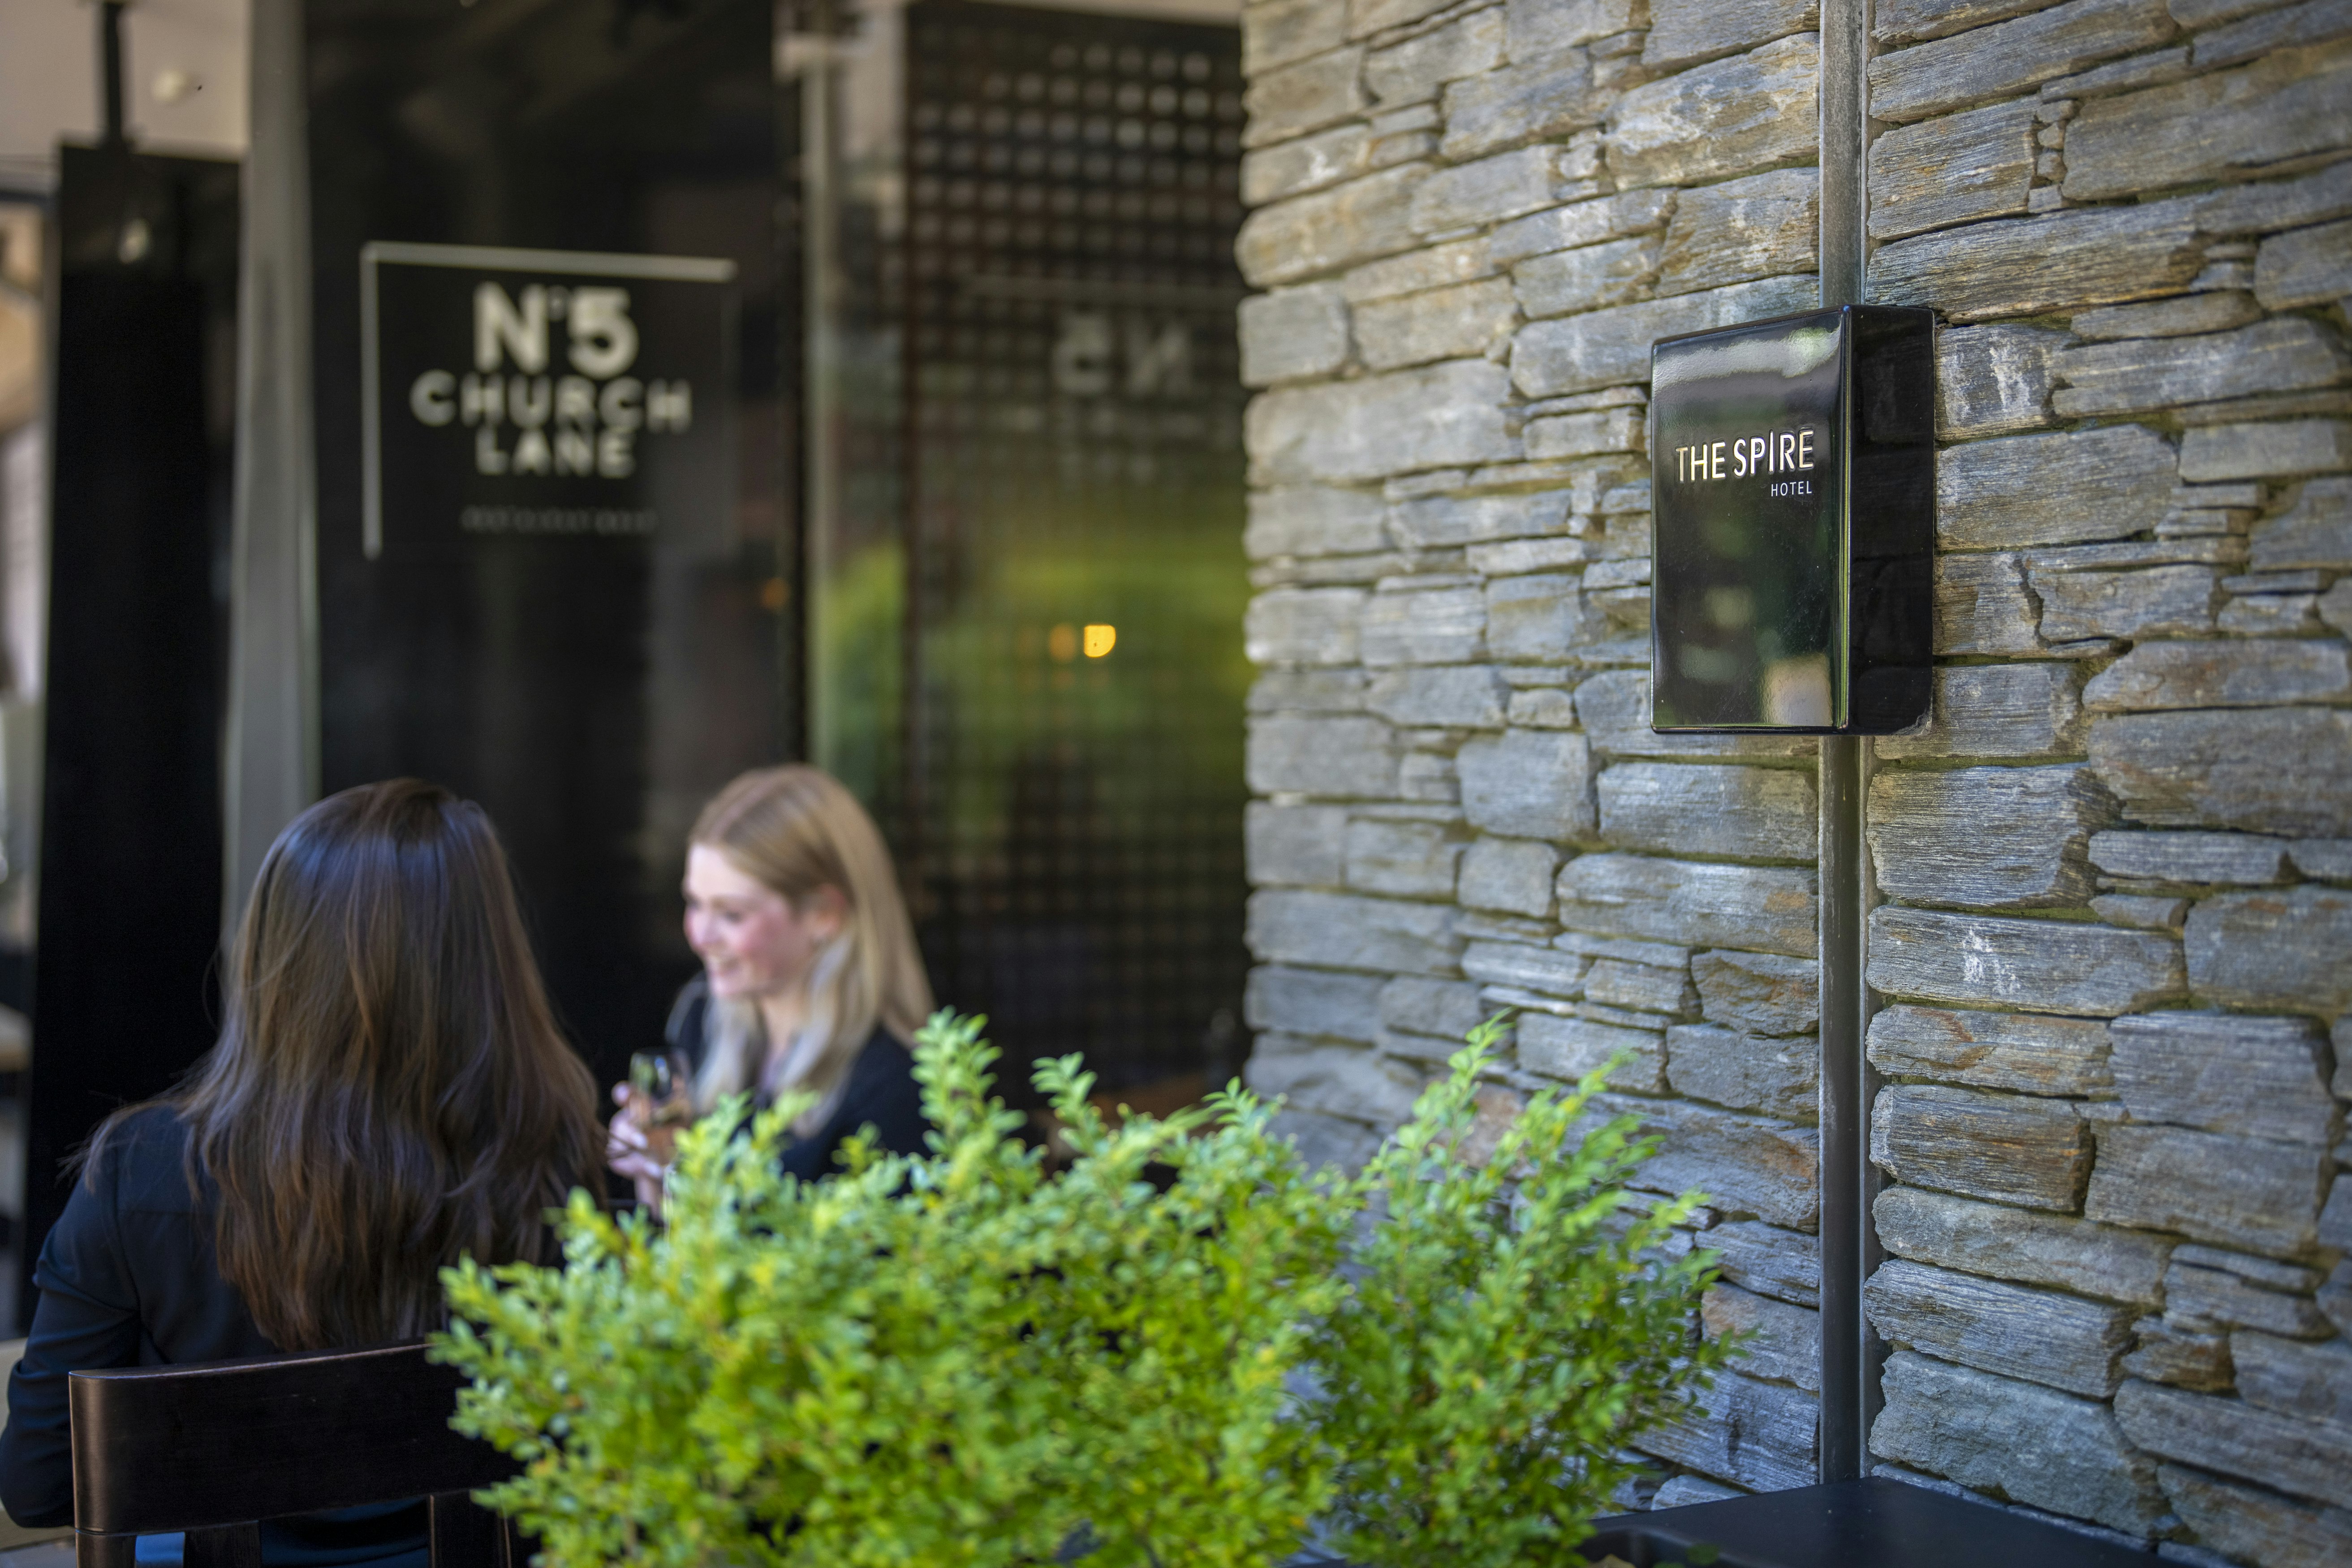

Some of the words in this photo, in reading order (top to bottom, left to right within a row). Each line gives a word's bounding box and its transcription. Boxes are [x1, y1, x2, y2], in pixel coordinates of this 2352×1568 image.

[409, 369, 692, 434] CHURCH
[476, 426, 635, 478] LANE
[1675, 441, 1726, 483] THE
[1733, 430, 1814, 477] SPIRE
[1770, 480, 1812, 497] HOTEL
